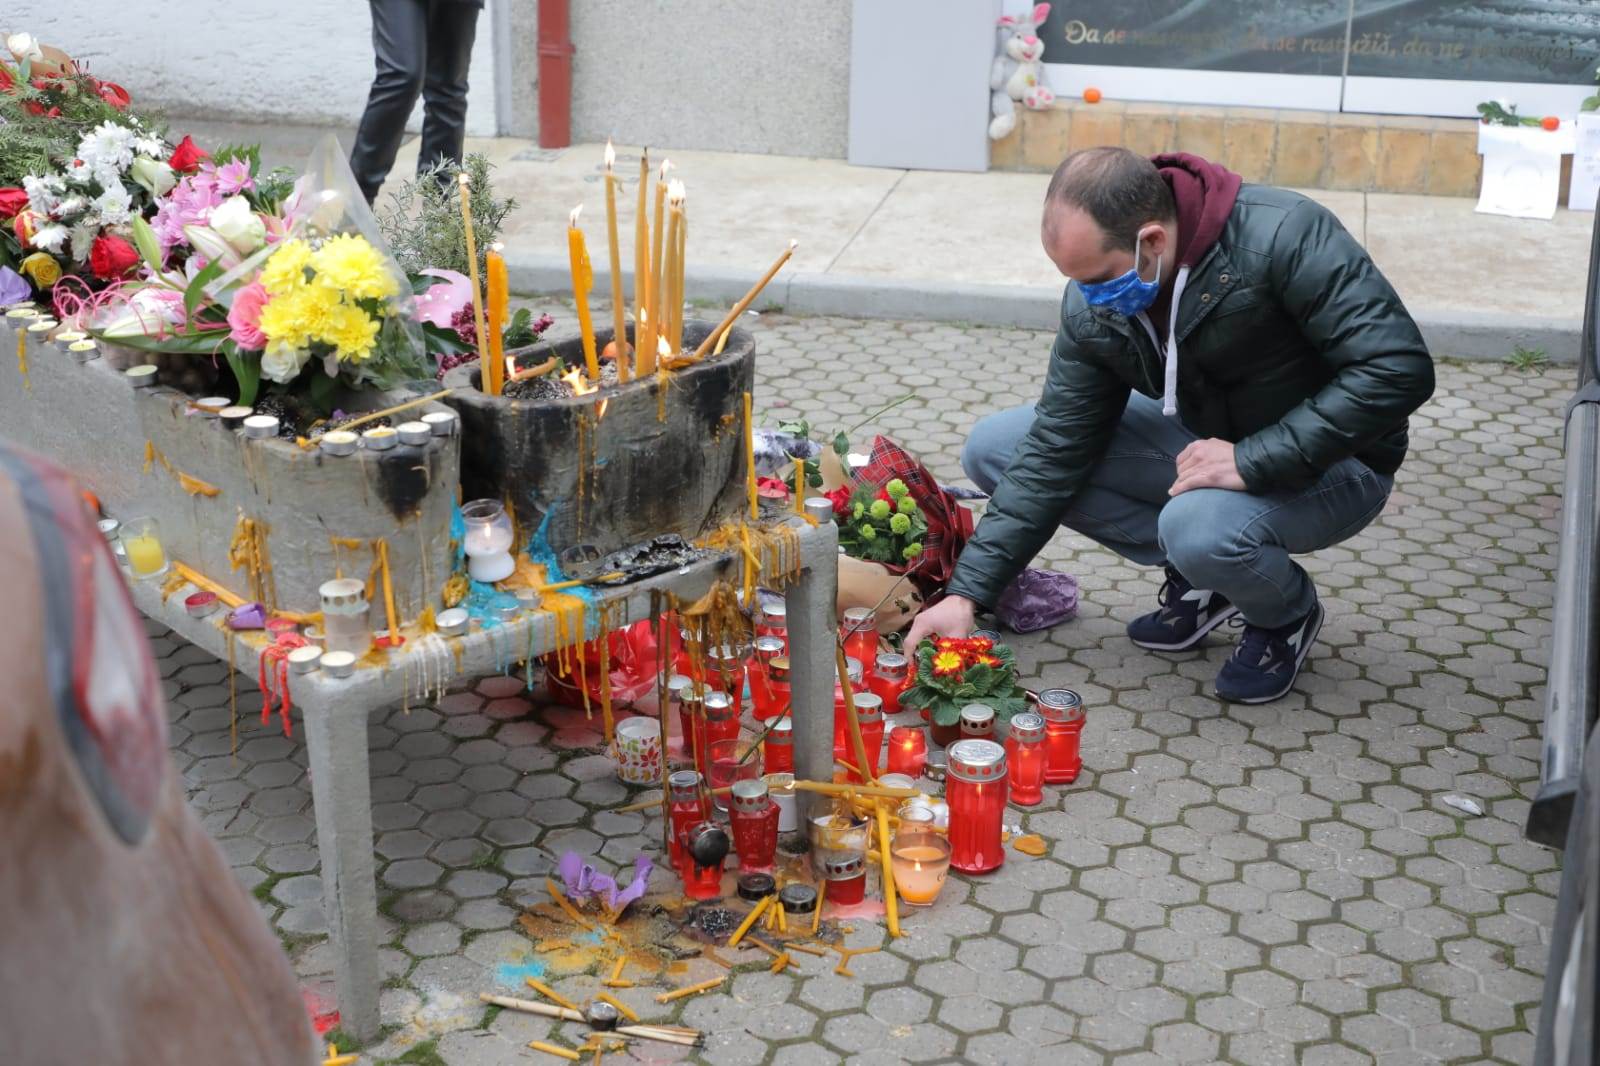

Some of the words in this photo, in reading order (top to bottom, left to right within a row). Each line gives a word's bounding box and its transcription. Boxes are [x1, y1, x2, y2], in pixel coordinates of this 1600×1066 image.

[1103, 29, 1127, 44] se
[1273, 36, 1297, 51] se
[1403, 36, 1432, 57] da
[1439, 41, 1465, 58] ne
